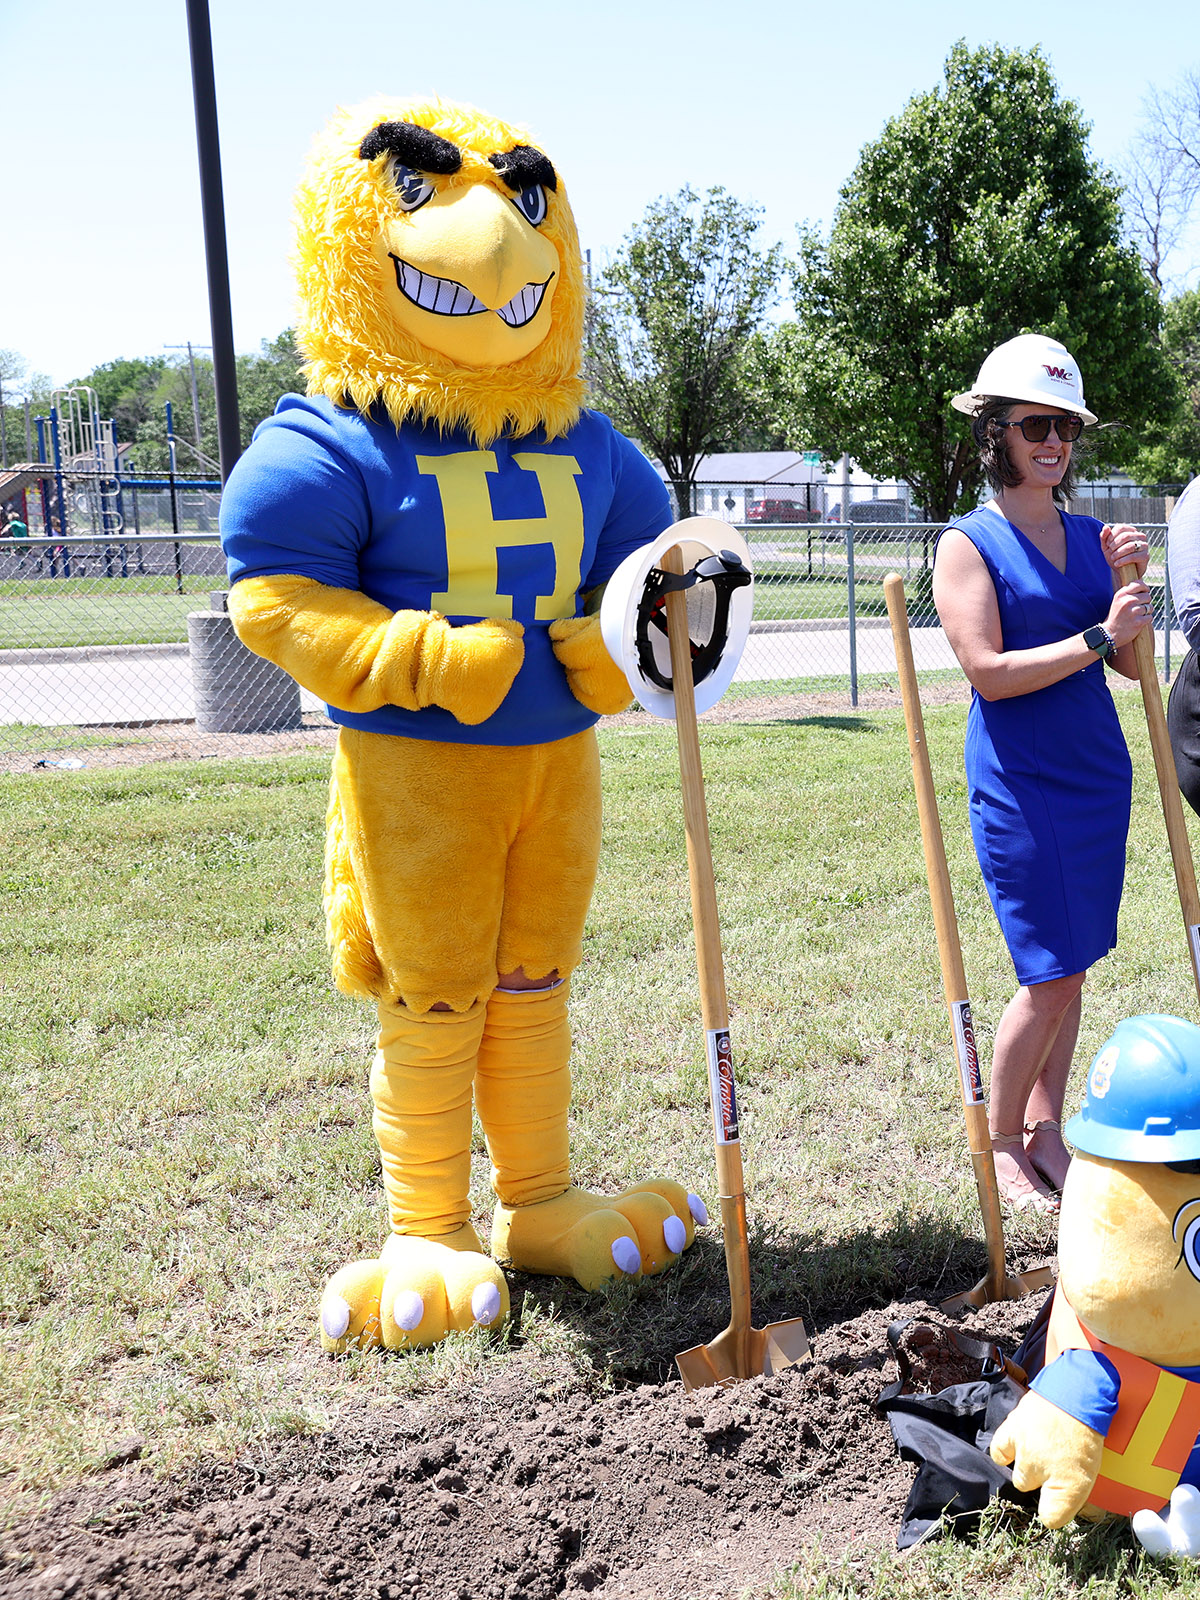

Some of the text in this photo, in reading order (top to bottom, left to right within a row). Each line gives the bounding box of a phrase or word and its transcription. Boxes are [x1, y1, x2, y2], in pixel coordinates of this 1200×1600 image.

[416, 451, 583, 621] H
[717, 1053, 734, 1122] Classic
[963, 1025, 980, 1085] Classic
